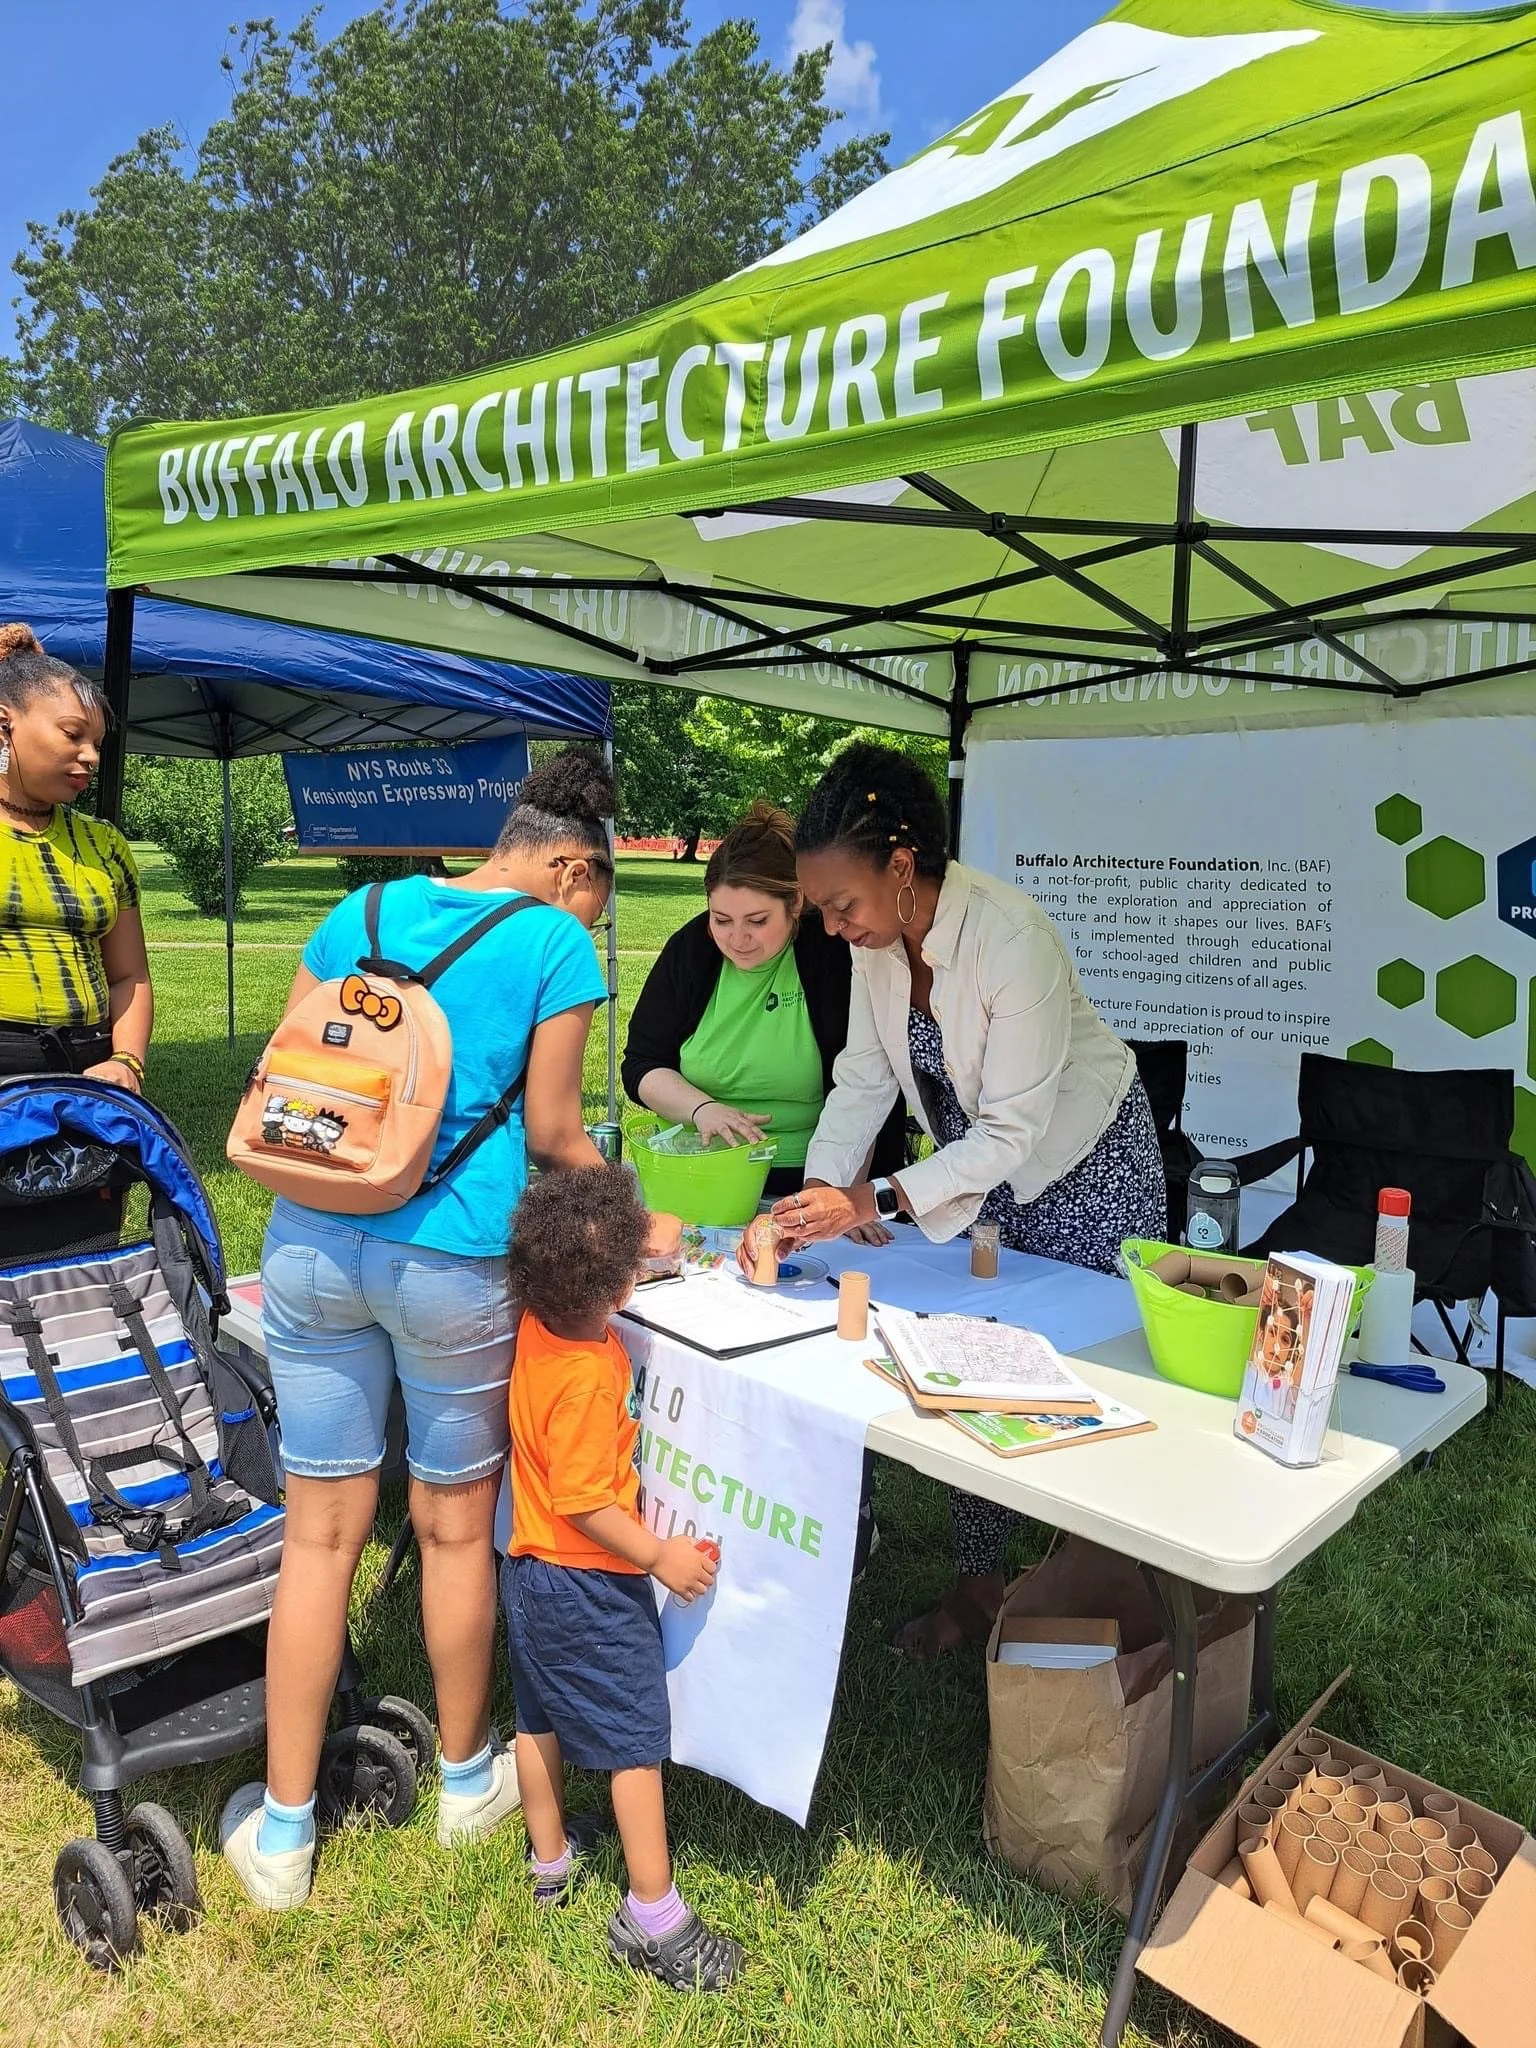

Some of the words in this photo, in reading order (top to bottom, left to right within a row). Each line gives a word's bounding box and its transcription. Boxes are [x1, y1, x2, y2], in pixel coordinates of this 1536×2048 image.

[158, 420, 368, 525] BUFFALO
[384, 291, 949, 503] ARCHITECTURE
[977, 109, 1536, 400] FOUNDA
[347, 760, 383, 782] NYS
[386, 759, 432, 777] Route
[432, 757, 453, 776] 33
[302, 786, 378, 808] Kensington
[382, 782, 474, 806] Expressway
[1015, 854, 1068, 867] Buffalo
[1073, 855, 1164, 869] Architecture
[1169, 858, 1263, 872] Foundation,
[1267, 859, 1291, 872] Inc.
[1295, 859, 1331, 874] (BAF)
[1015, 873, 1024, 884] is
[1033, 875, 1040, 885] a
[1048, 874, 1131, 888] not-for-profit,
[1140, 876, 1178, 890] public
[1187, 878, 1231, 893] charity
[1240, 878, 1307, 892] dedicated
[1317, 881, 1332, 892] to
[1077, 892, 1097, 904] the
[1107, 894, 1177, 908] exploration
[1187, 897, 1212, 909] and
[1222, 899, 1306, 912] appreciation
[1318, 899, 1332, 912] of
[1511, 905, 1536, 919] PR
[1093, 911, 1117, 923] and
[1124, 912, 1151, 925] how
[1158, 914, 1167, 926] it
[1174, 915, 1218, 930] shapes
[1225, 919, 1248, 929] our
[1255, 917, 1288, 931] lives.
[1071, 928, 1080, 939] is
[1091, 930, 1175, 944] implemented
[1186, 934, 1239, 950] through
[1251, 937, 1332, 952] educational
[1076, 946, 1093, 958] for
[1102, 948, 1179, 965] school-aged
[1188, 952, 1242, 967] children
[1252, 957, 1278, 970] and
[1288, 958, 1332, 973] public
[1078, 967, 1119, 979] events
[1122, 969, 1182, 986] engaging
[1185, 971, 1234, 986] citizens
[1237, 974, 1252, 987] of
[1253, 975, 1268, 988] all
[1272, 980, 1308, 992] ages.
[1135, 999, 1208, 1017] Foundation
[1211, 1004, 1221, 1018] is
[1224, 1006, 1264, 1022] proud
[1267, 1009, 1281, 1022] to
[1284, 1010, 1331, 1028] inspire
[1113, 1017, 1137, 1029] and
[1143, 1019, 1224, 1037] appreciation
[1230, 1025, 1246, 1038] of
[1251, 1029, 1274, 1041] our
[1281, 1032, 1330, 1047] unique
[1187, 1071, 1222, 1085] vities
[1186, 1132, 1249, 1148] wareness
[640, 1423, 824, 1558] ITECTURE
